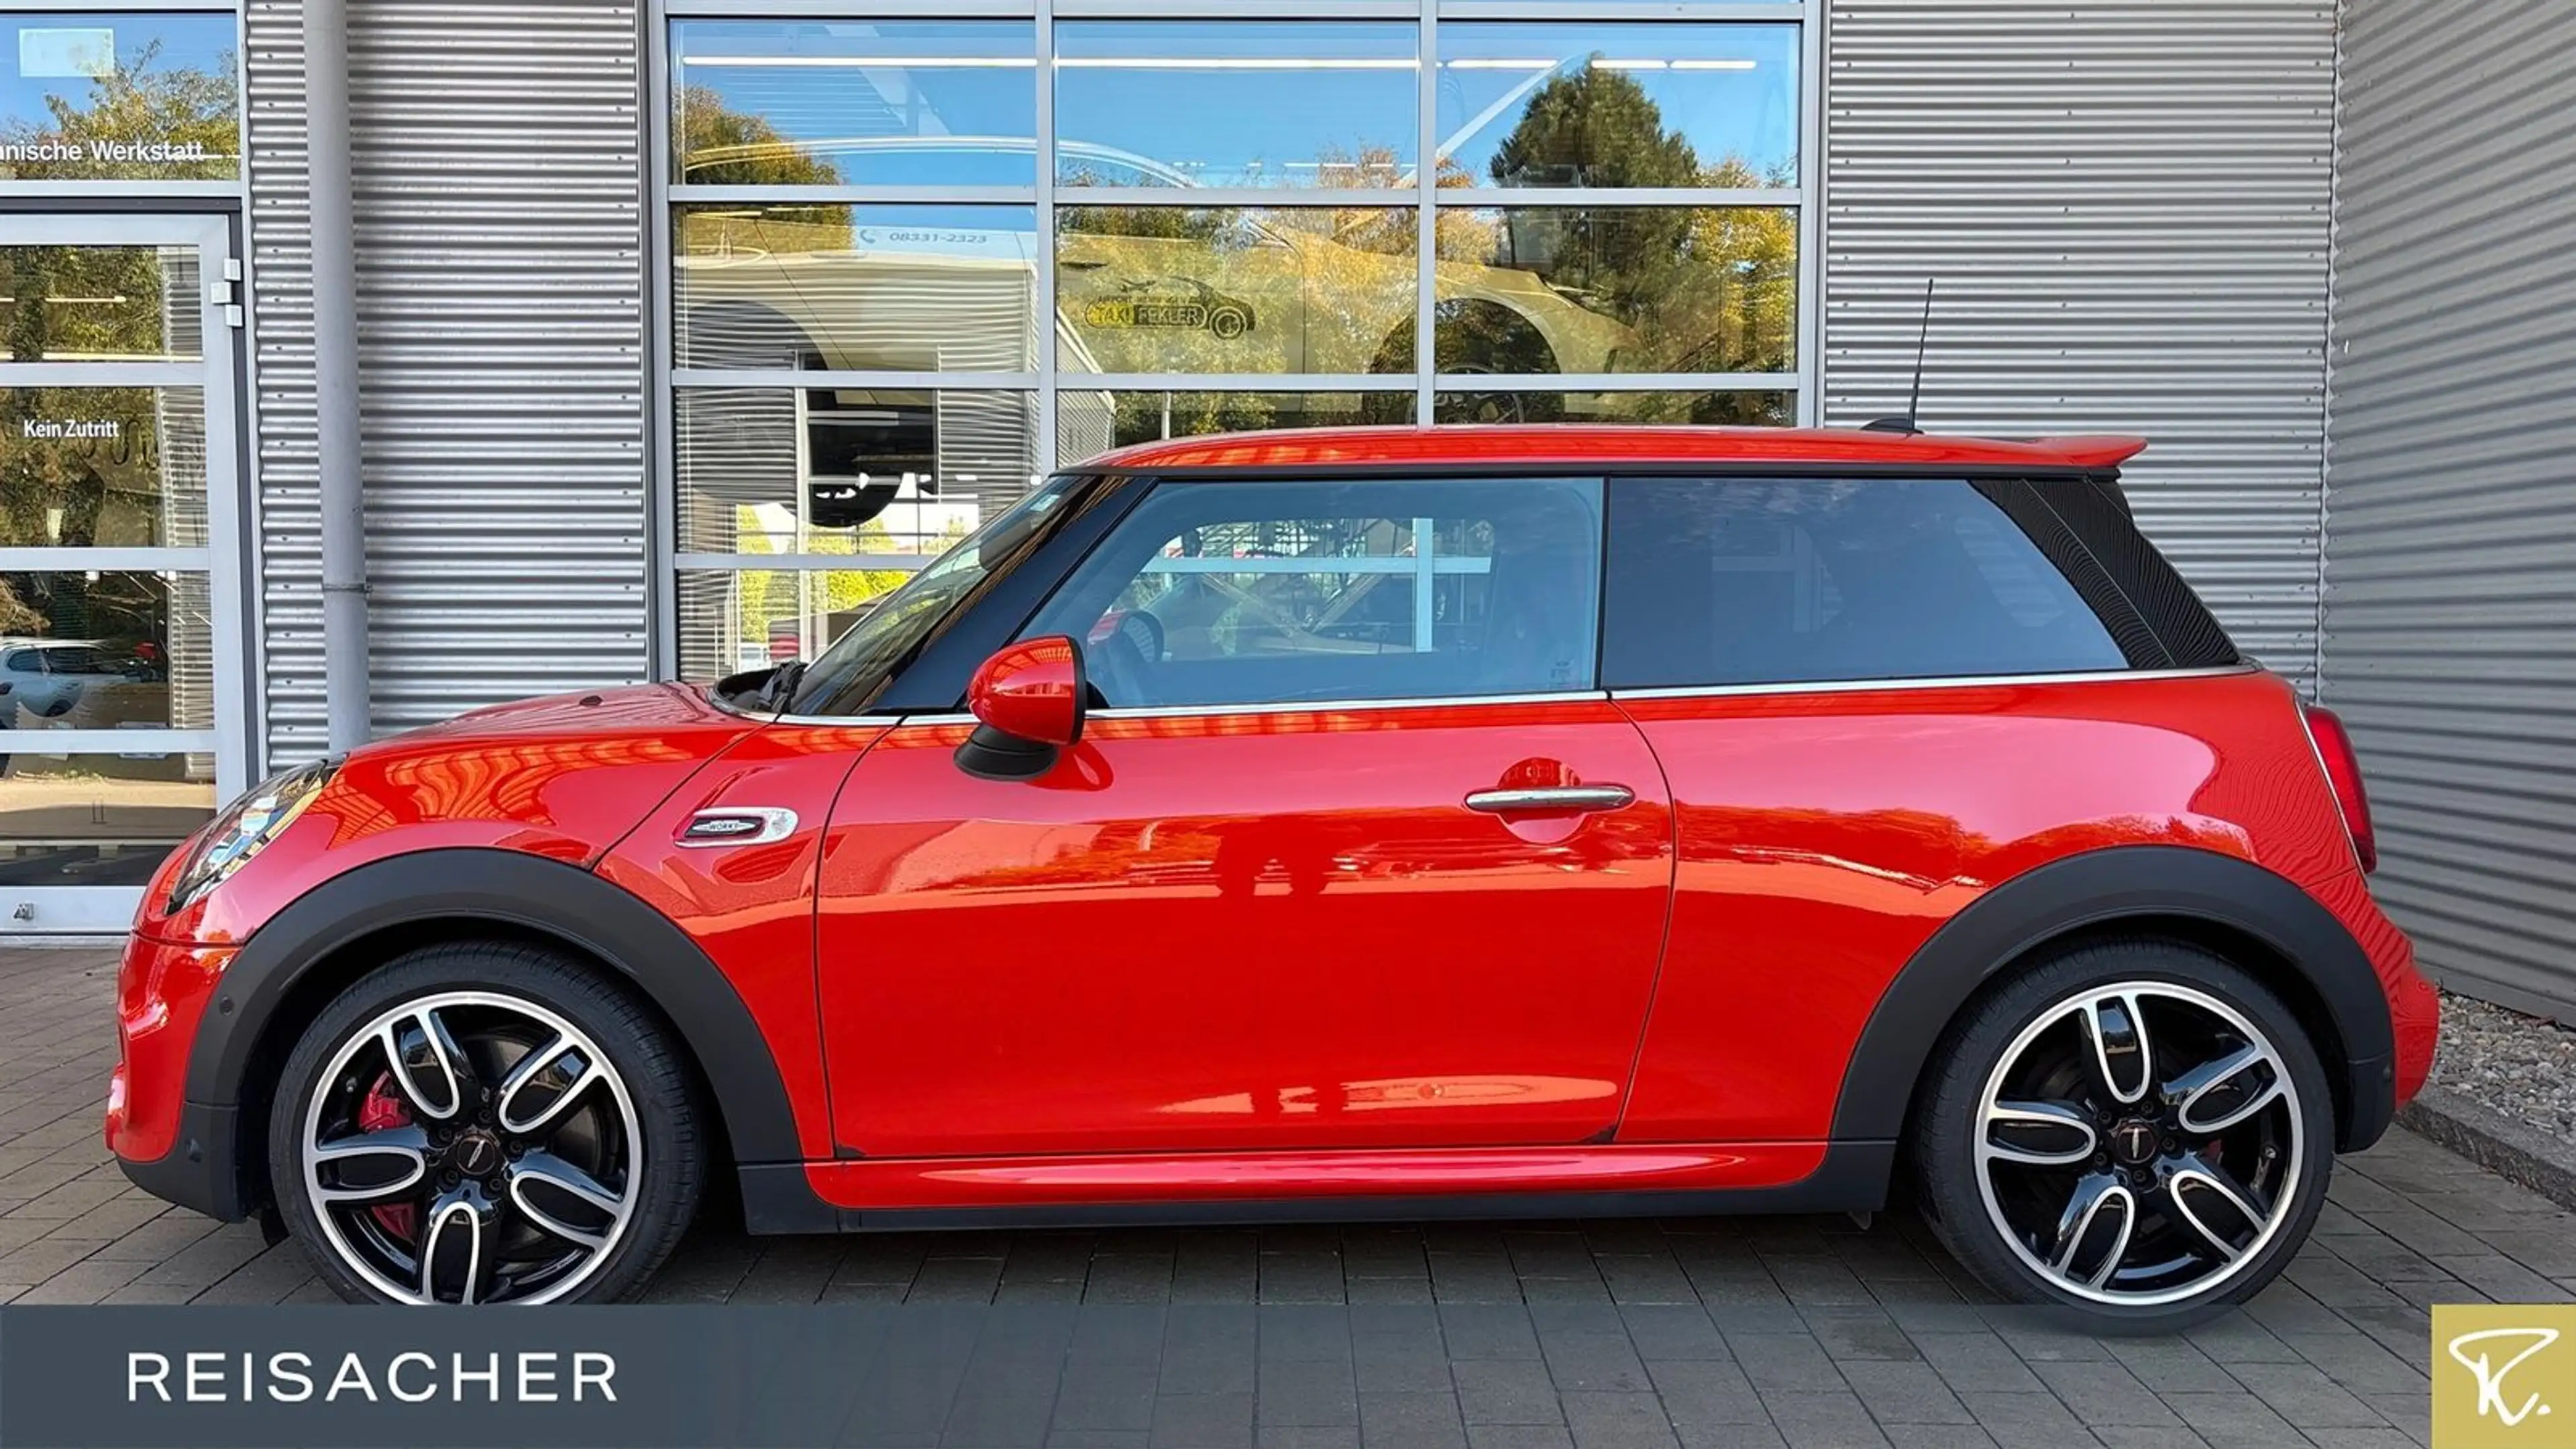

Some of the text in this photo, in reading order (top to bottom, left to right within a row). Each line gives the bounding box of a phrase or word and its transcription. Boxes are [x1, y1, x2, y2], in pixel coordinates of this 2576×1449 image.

[91, 140, 203, 161] Werkstatt
[24, 419, 119, 437] Kein Zutritt
